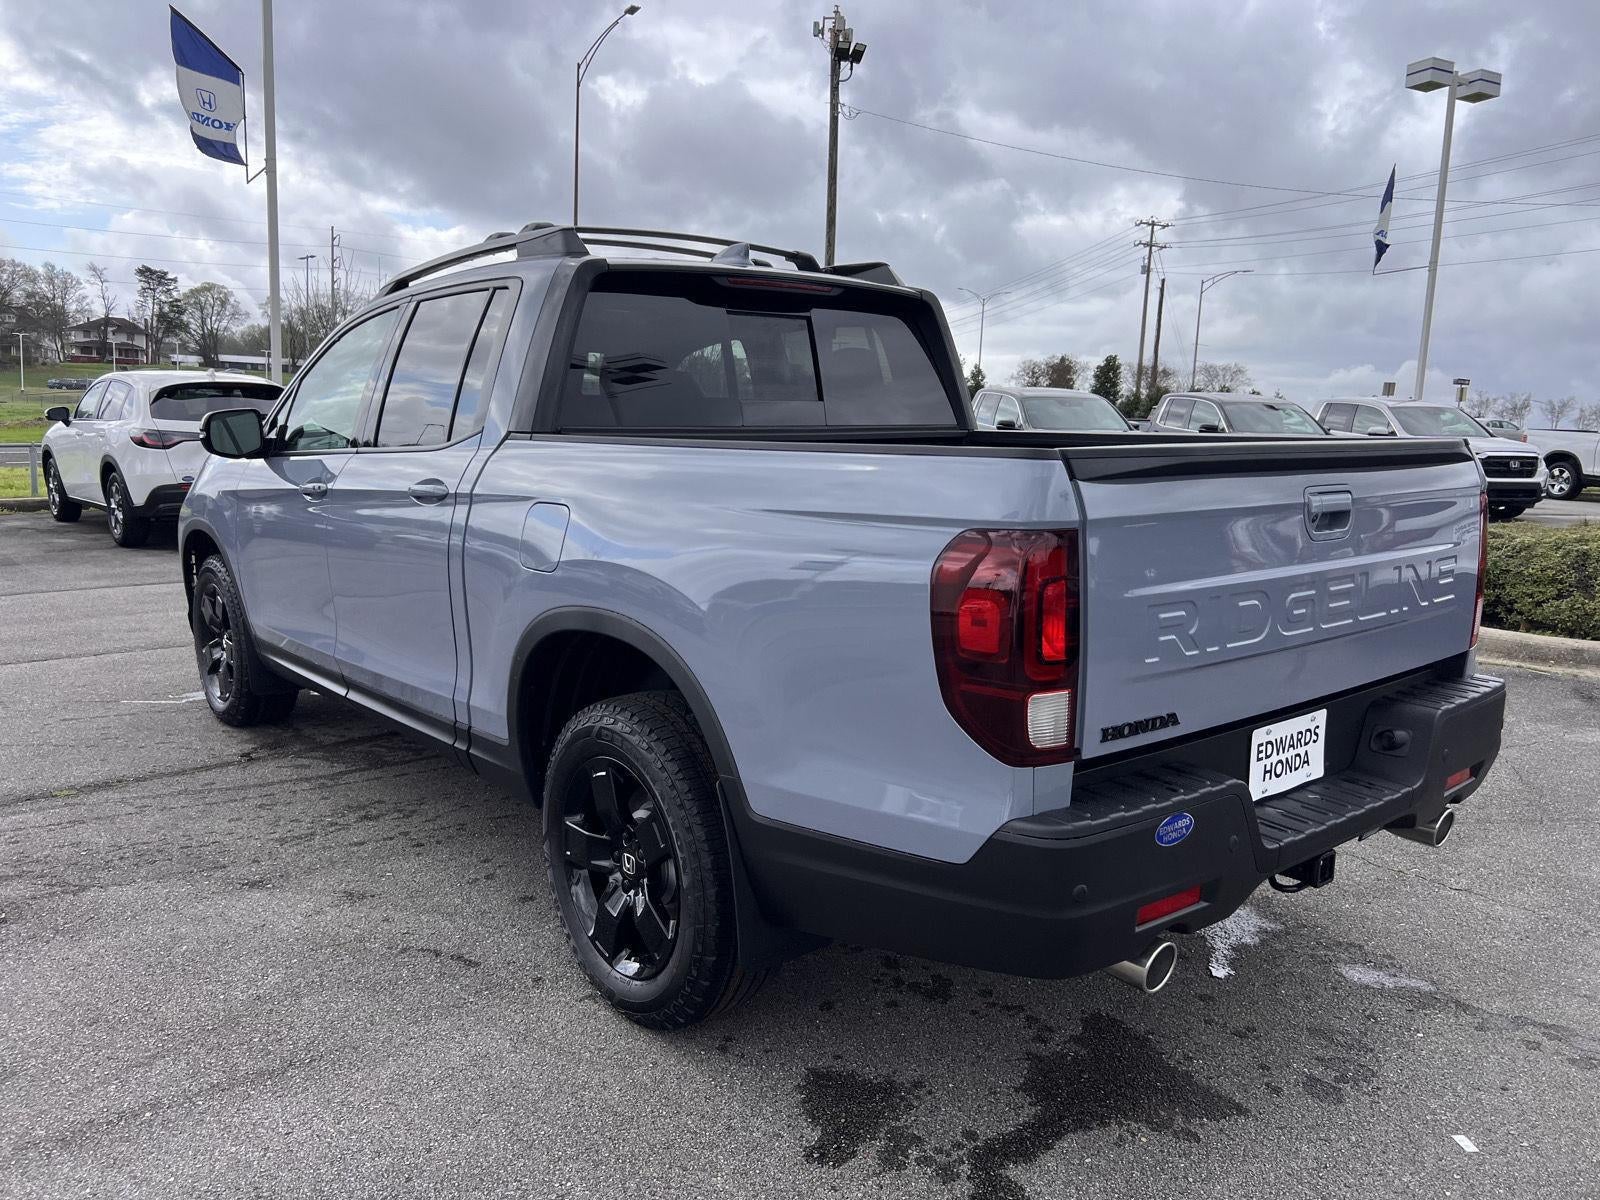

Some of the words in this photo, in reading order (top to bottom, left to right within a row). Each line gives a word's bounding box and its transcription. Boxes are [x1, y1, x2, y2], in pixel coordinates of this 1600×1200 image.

[1145, 554, 1457, 663] RIDGELINE
[1100, 712, 1180, 743] HONDA
[1256, 725, 1319, 762] EDWARDS
[1263, 750, 1310, 782] HONDA
[1160, 817, 1190, 836] EDWARDS
[1163, 828, 1187, 843] HONDA
